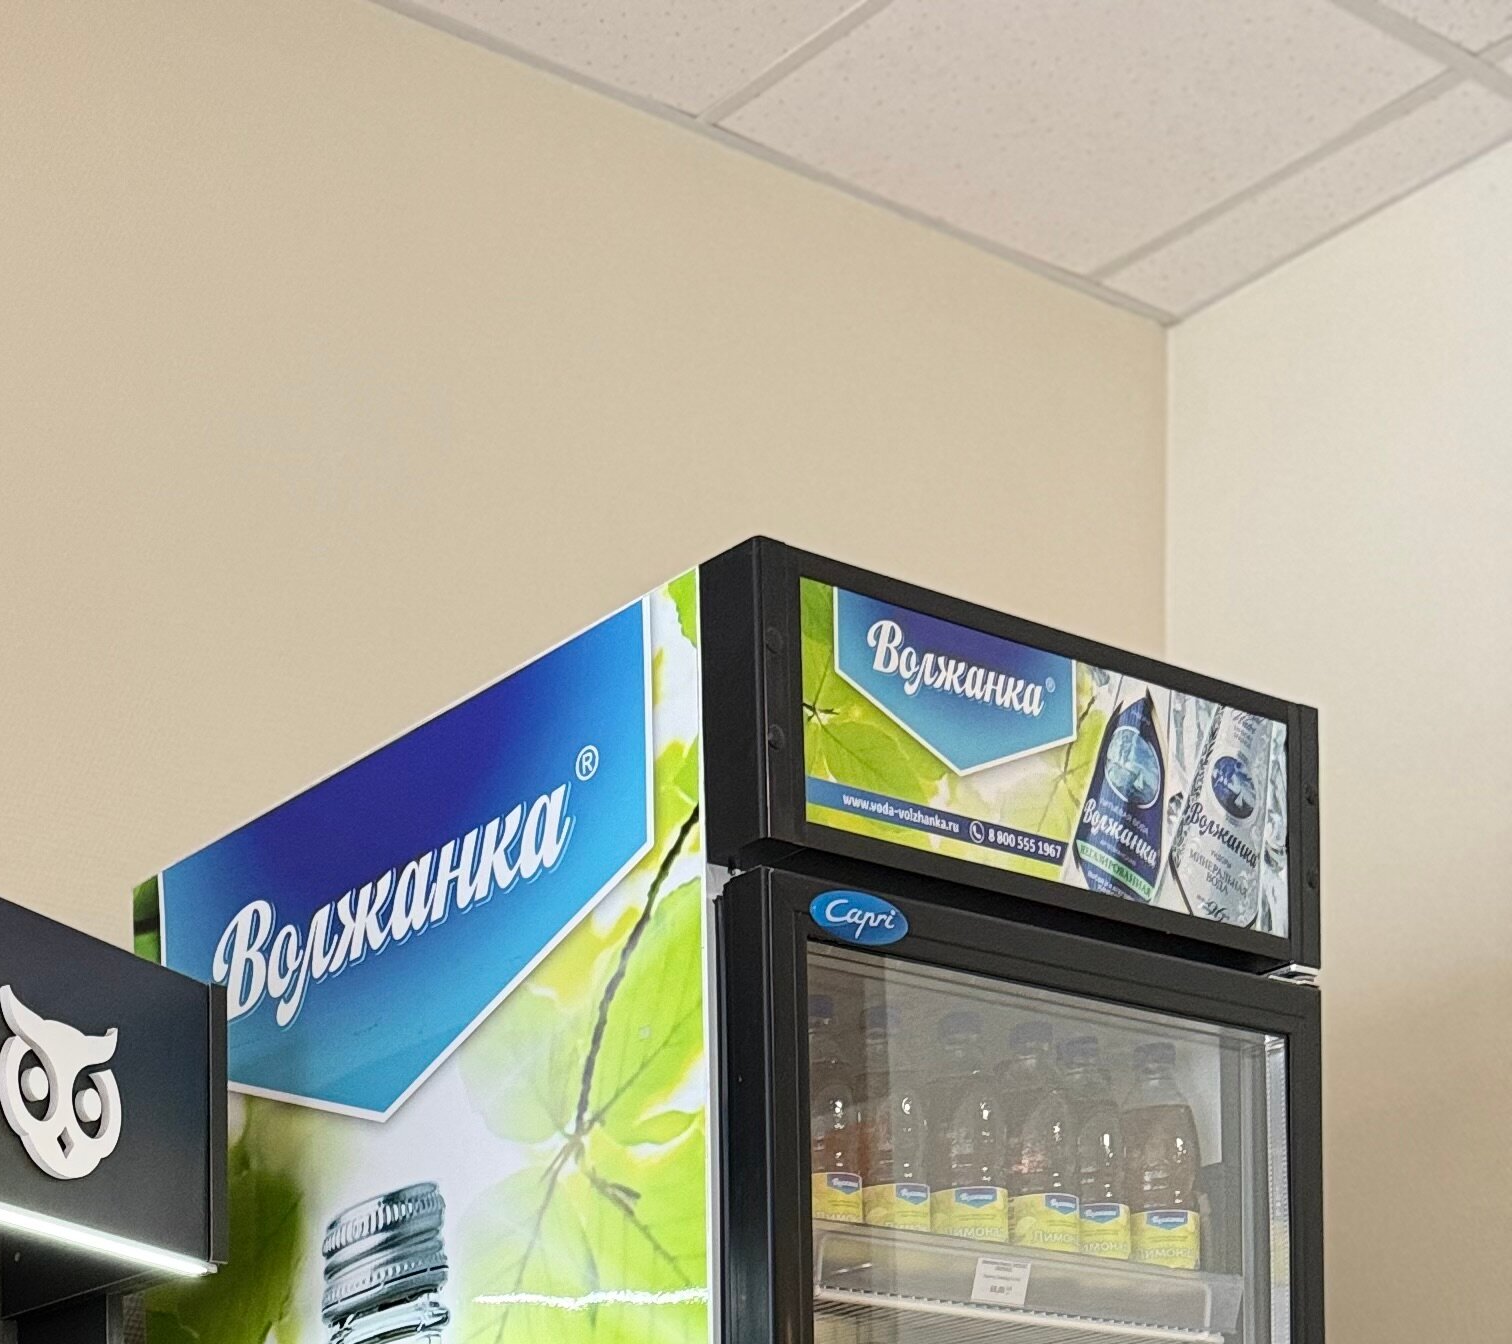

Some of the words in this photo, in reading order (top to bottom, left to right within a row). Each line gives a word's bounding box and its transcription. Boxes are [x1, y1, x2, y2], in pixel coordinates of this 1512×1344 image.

[867, 620, 1045, 716] Волжанка
[842, 793, 960, 833] www.voda-volzhanka.ru
[988, 828, 995, 842] 8
[996, 831, 1016, 848] 800
[1017, 836, 1036, 853] 555
[1037, 840, 1062, 859] 1967
[1083, 797, 1157, 869] Волжанка
[1189, 802, 1258, 869] Волжанка
[212, 782, 576, 1028] Волжанка
[825, 899, 896, 939] Capri
